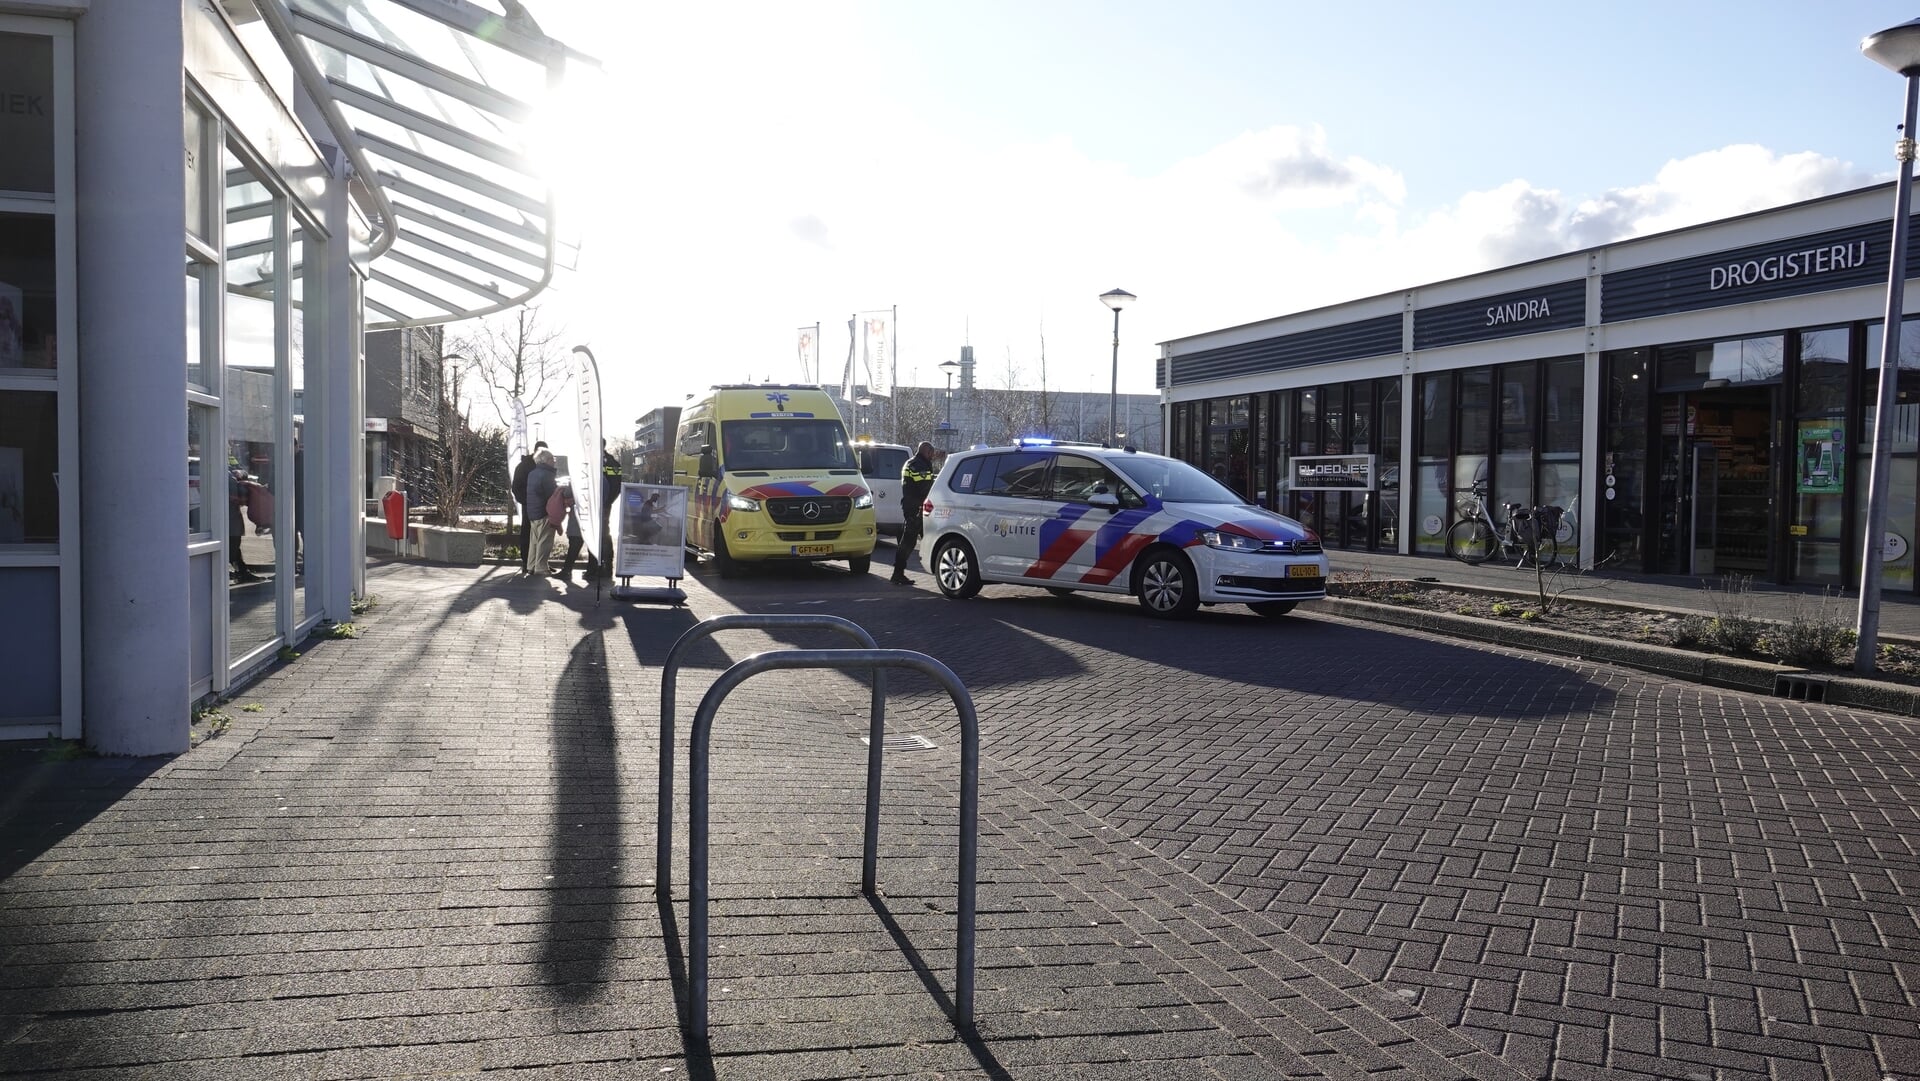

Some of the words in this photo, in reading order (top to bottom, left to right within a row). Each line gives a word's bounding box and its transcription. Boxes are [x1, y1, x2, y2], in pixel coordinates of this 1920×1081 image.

[0, 91, 44, 117] IEK
[1710, 241, 1866, 290] DROGISTERIJ
[1486, 297, 1550, 327] SANDRA
[994, 519, 1037, 537] POLITIE
